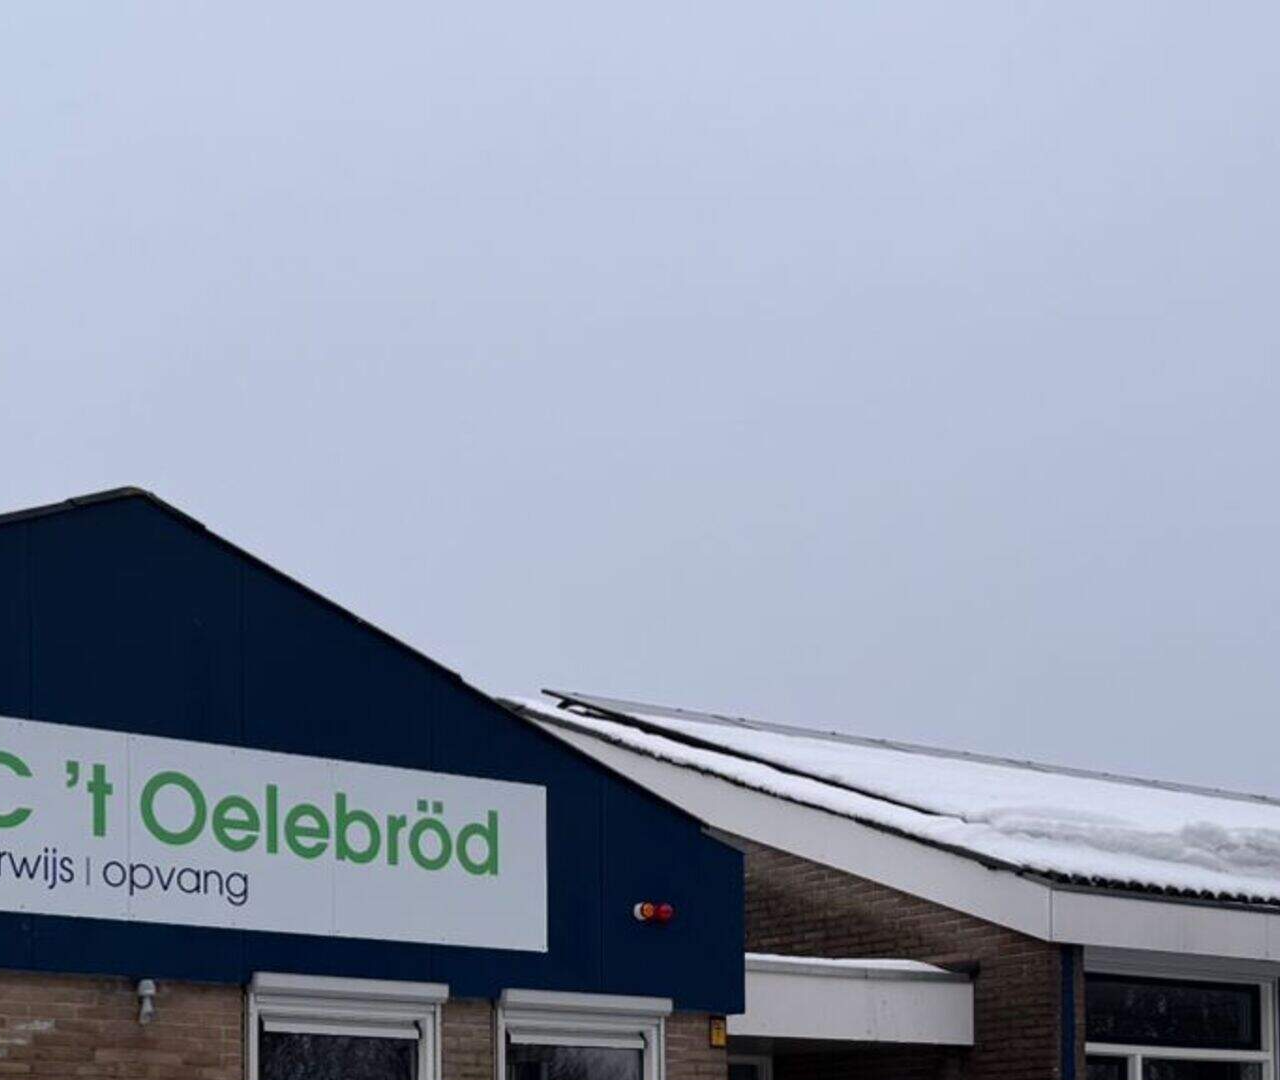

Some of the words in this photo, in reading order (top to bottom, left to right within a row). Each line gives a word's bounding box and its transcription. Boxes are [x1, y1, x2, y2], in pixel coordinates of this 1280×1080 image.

[66, 760, 113, 837] 't
[140, 771, 499, 876] Oelebröd
[102, 859, 249, 907] opvang
